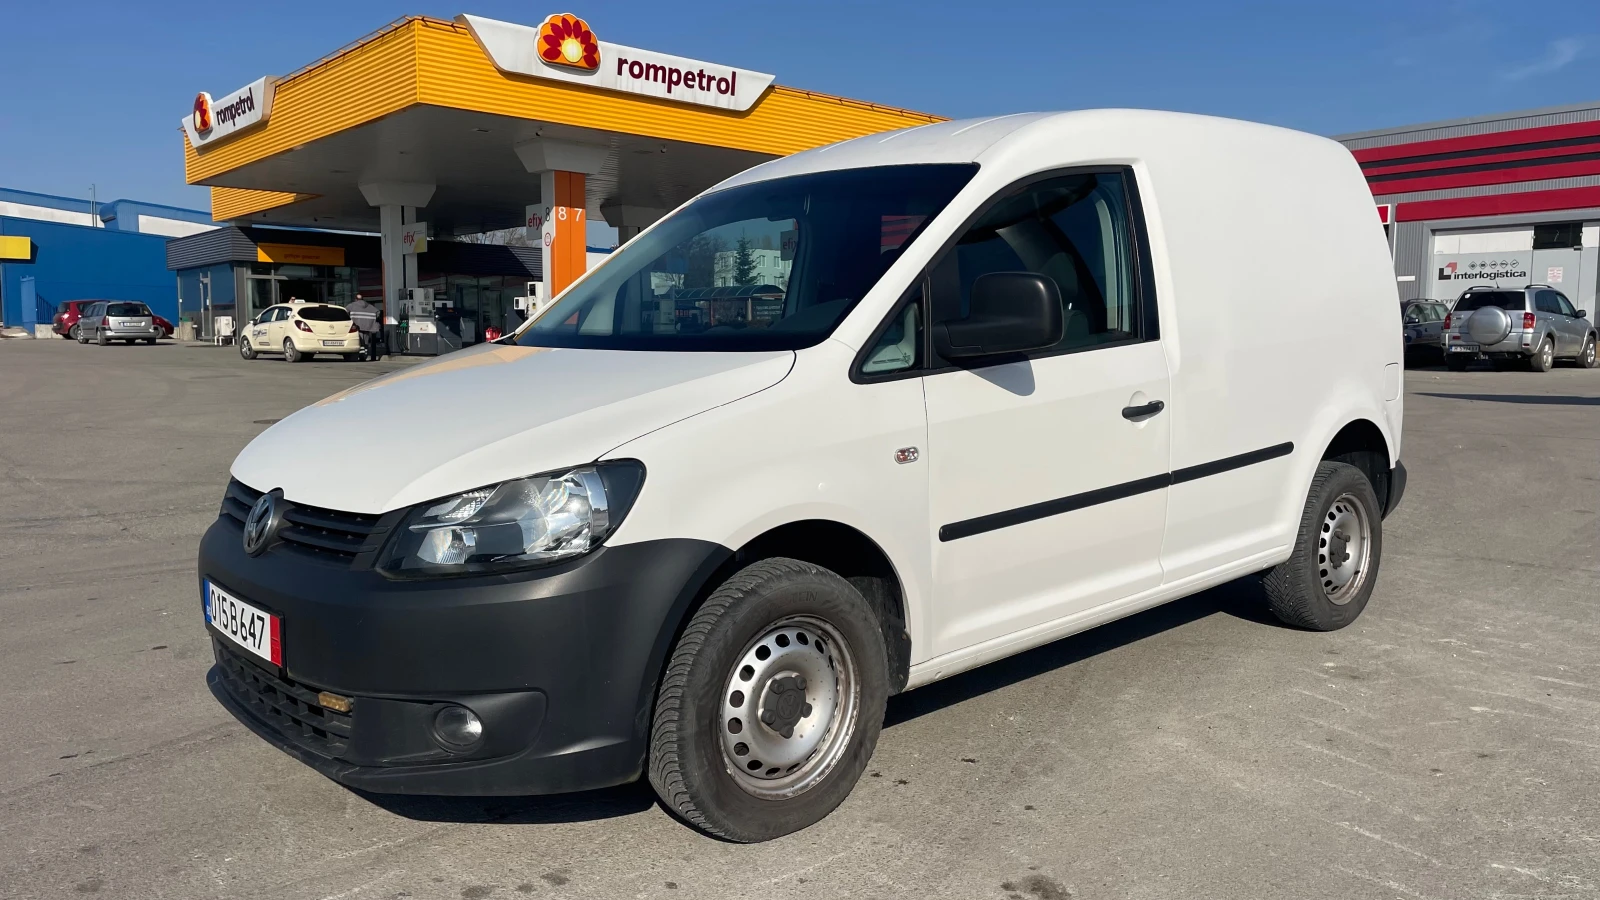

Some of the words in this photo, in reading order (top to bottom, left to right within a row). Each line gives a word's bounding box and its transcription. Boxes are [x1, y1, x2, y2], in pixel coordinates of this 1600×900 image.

[617, 57, 737, 96] rompetrol
[215, 87, 255, 127] rompetrol
[545, 207, 551, 222] 8
[558, 206, 567, 221] 8
[574, 208, 583, 222] 7
[1454, 269, 1527, 280] interlogistica
